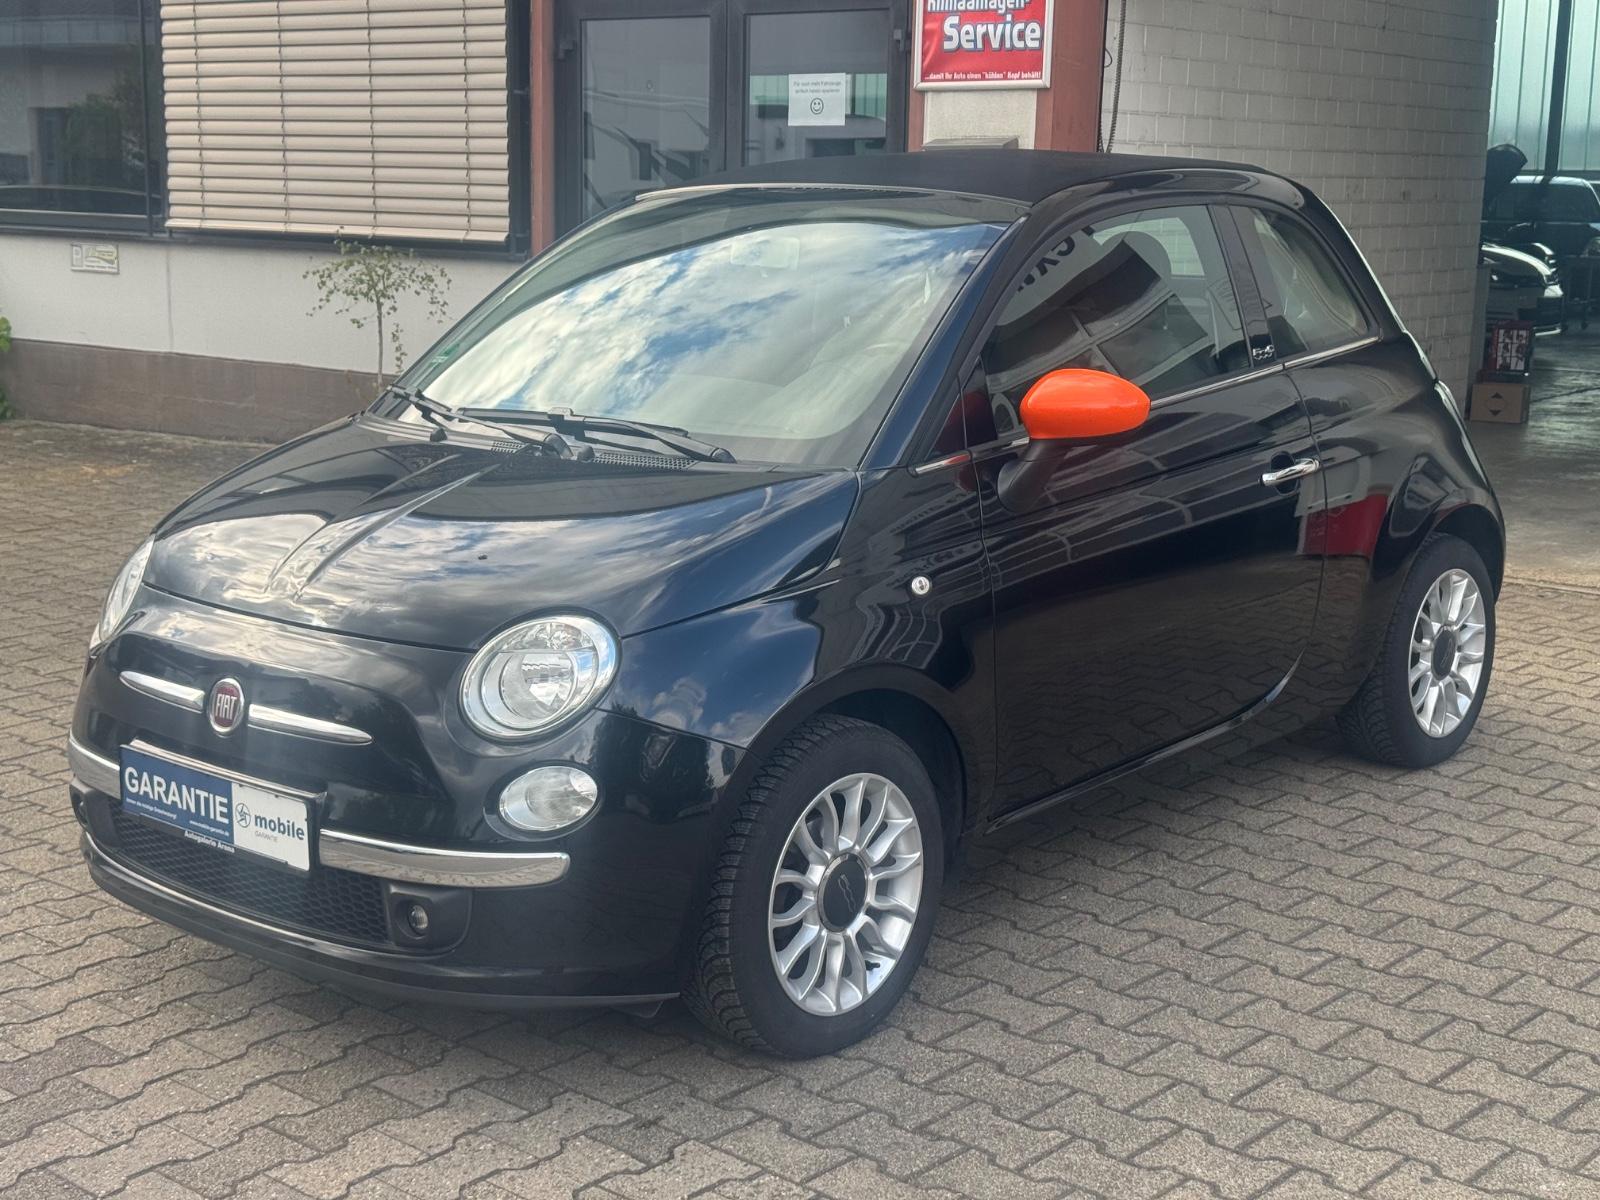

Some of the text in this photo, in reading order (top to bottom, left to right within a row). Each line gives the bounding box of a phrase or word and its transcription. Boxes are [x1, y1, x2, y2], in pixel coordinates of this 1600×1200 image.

[943, 14, 1041, 50] Service
[215, 693, 238, 720] FIAT
[124, 766, 230, 824] GARANTIE
[254, 813, 305, 841] mobile
